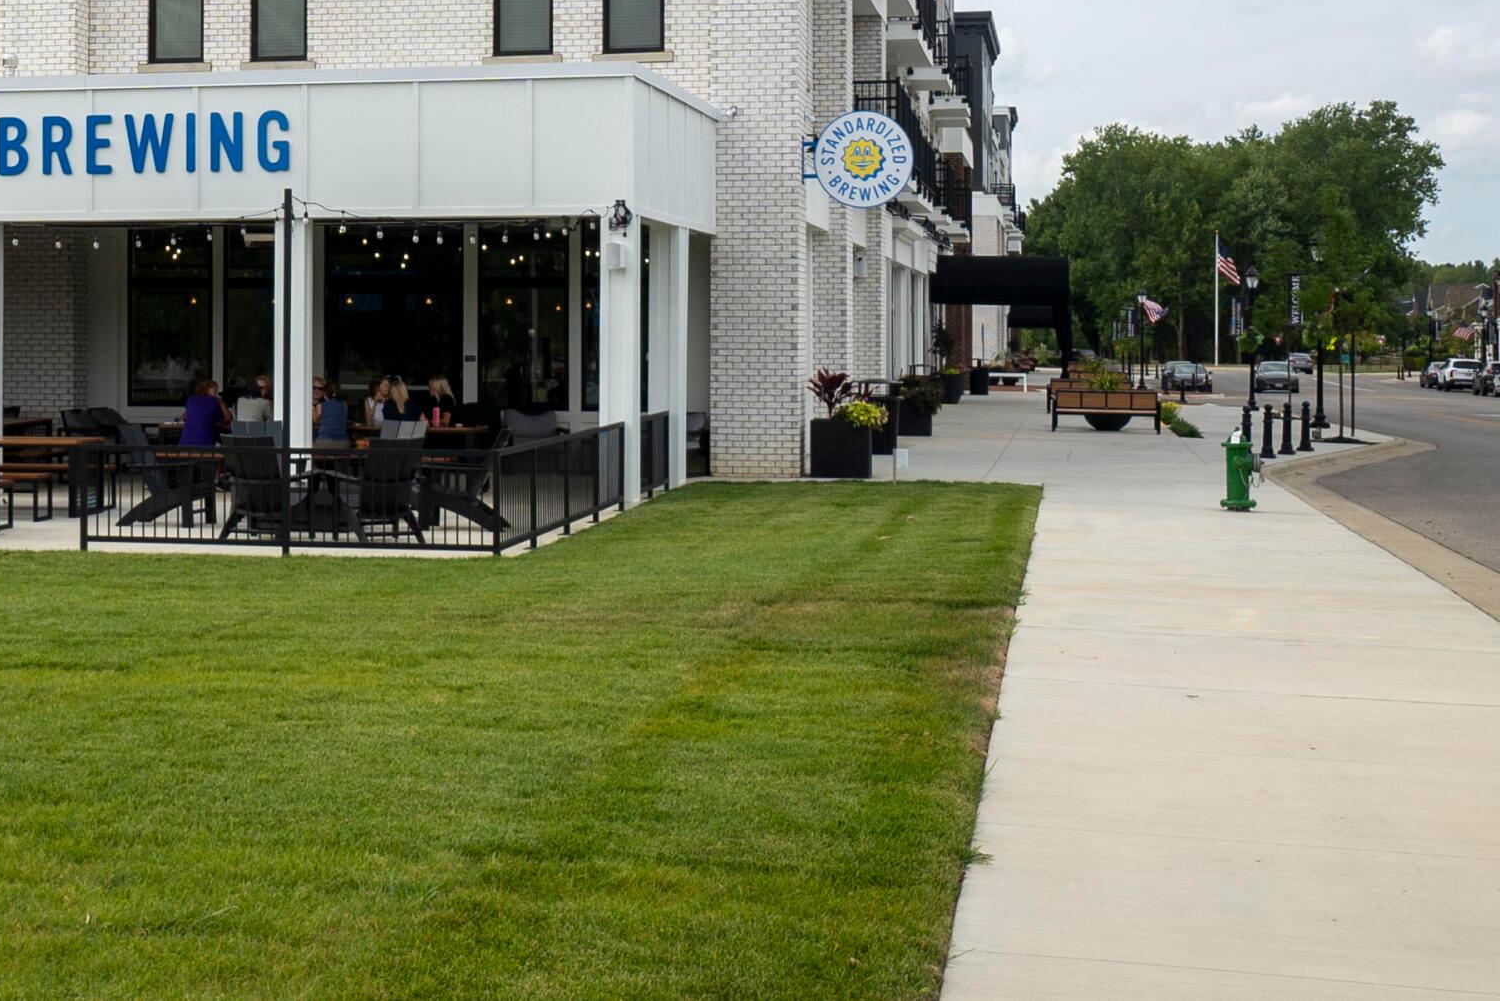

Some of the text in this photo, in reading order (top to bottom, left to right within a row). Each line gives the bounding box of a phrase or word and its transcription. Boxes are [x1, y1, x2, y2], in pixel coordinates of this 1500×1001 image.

[820, 117, 907, 166] STANDARDIZED
[828, 174, 900, 202] BREWING
[1291, 275, 1300, 324] WELCOME
